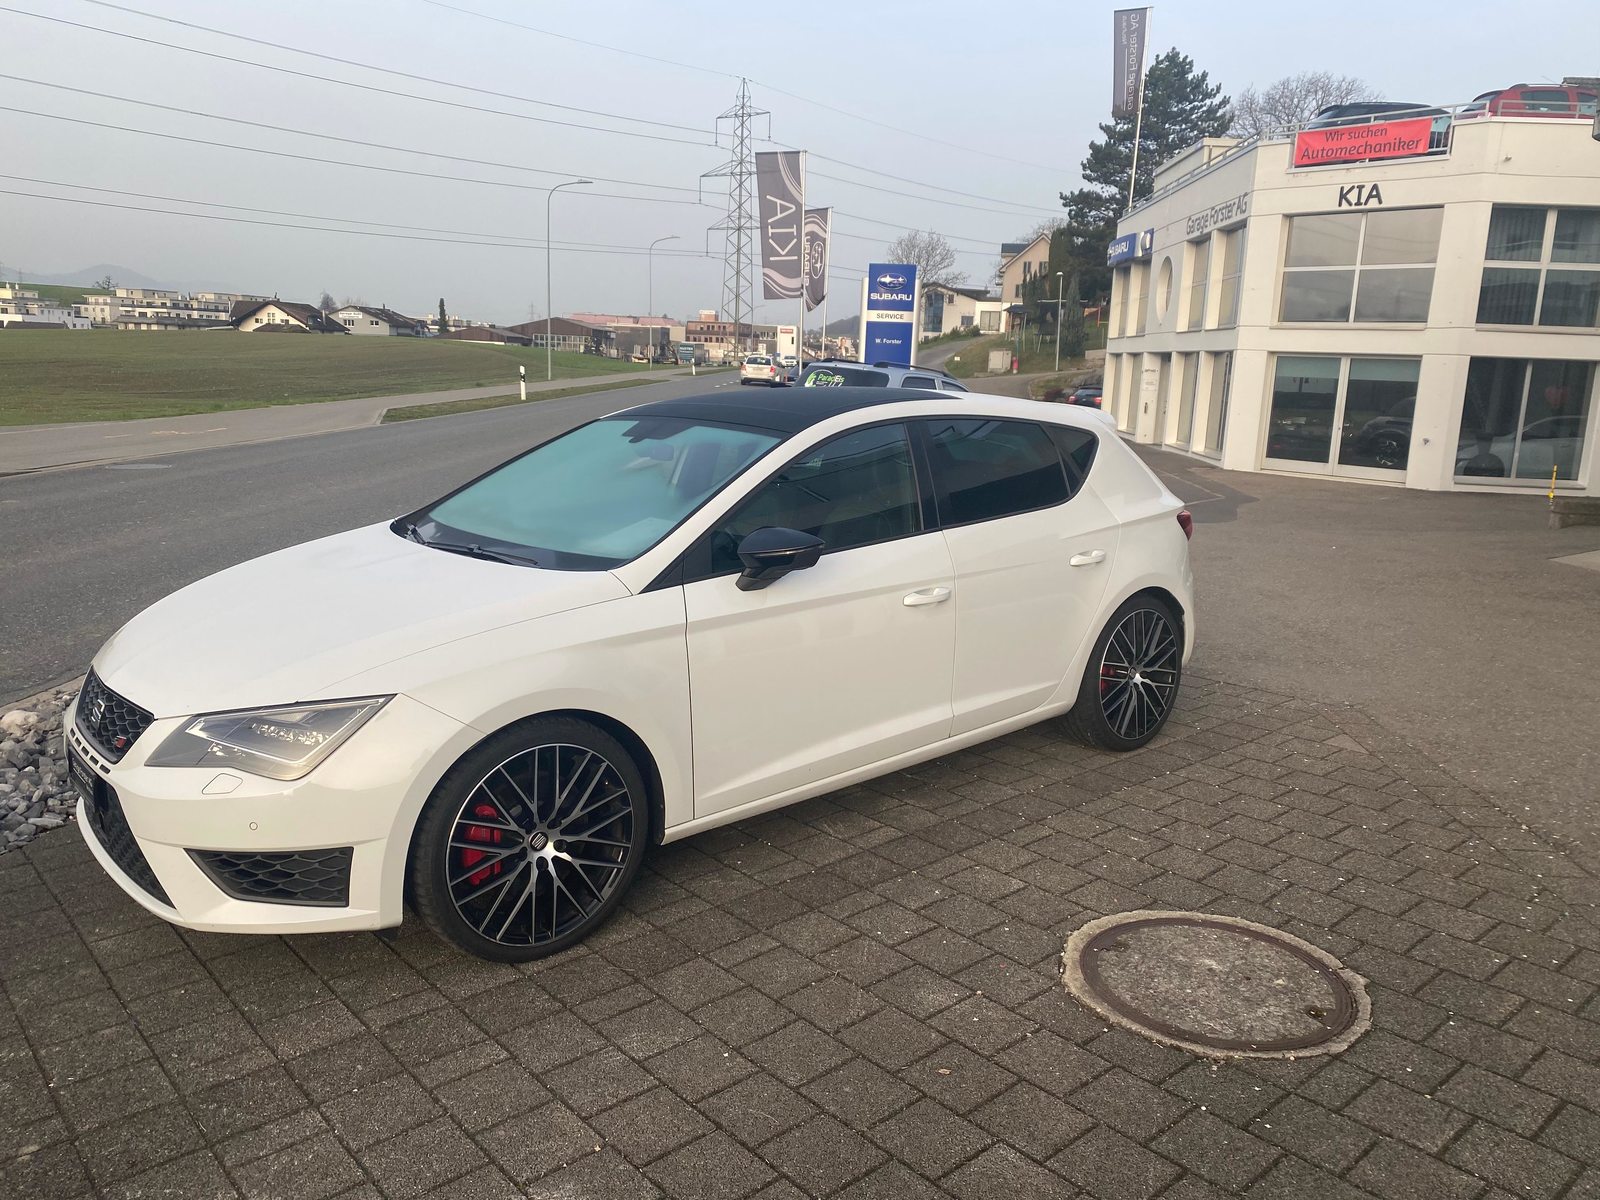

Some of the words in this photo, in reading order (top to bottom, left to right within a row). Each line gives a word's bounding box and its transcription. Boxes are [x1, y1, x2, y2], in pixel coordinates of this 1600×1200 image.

[1325, 131, 1345, 142] Wir
[1347, 127, 1388, 141] suchen
[1300, 138, 1422, 161] Automechaniker
[1338, 183, 1383, 207] KIA
[1186, 213, 1209, 235] Garage
[1209, 202, 1236, 226] Forster
[1236, 192, 1249, 216] AG
[870, 293, 911, 301] SUBARU
